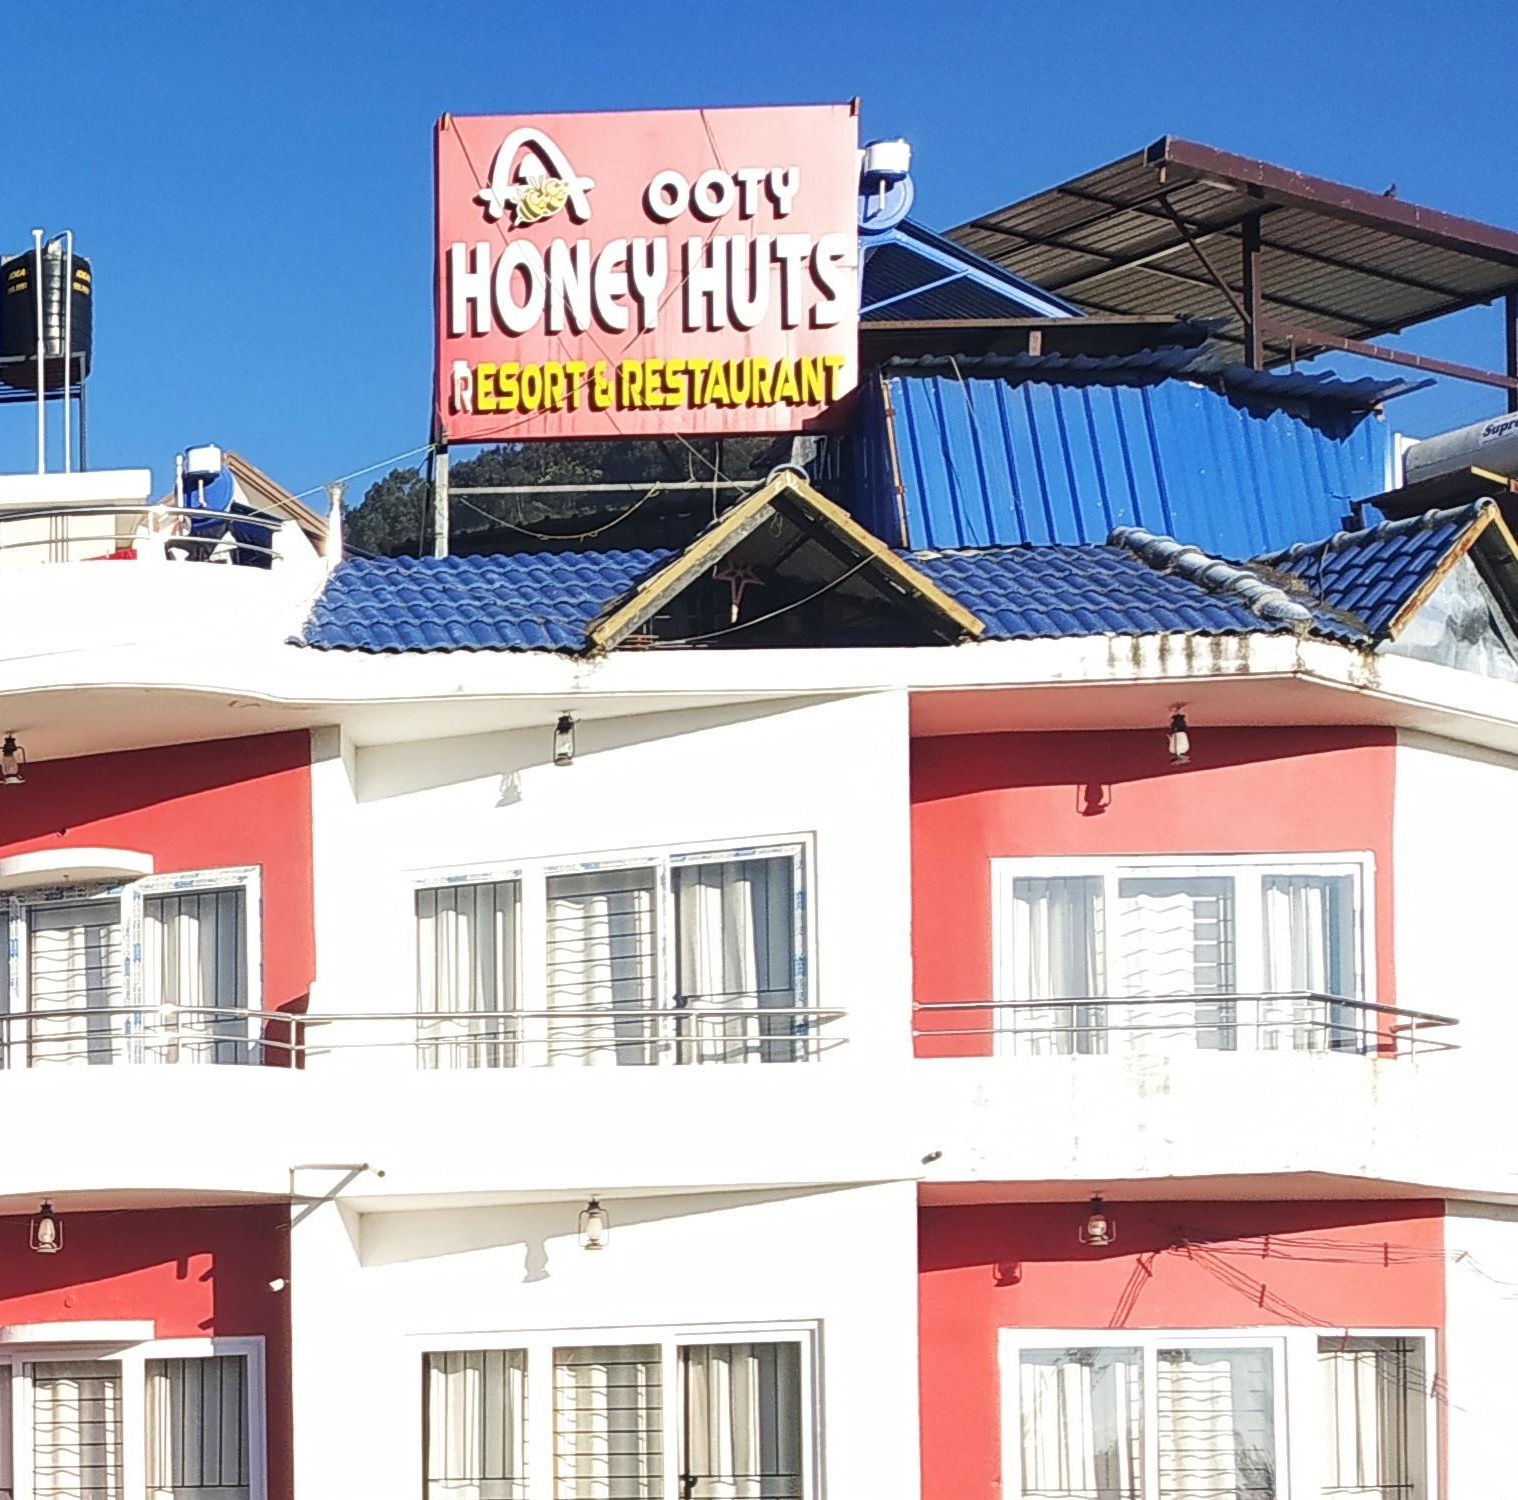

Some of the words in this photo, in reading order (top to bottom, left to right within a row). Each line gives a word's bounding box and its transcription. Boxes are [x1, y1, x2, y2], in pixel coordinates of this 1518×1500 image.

[477, 127, 595, 220] A
[645, 166, 800, 219] OOTY
[448, 237, 669, 334] HONEY
[686, 232, 858, 331] HUTS
[452, 359, 588, 413] RESORT
[593, 360, 614, 408] &
[620, 354, 846, 409] RESTAURANT
